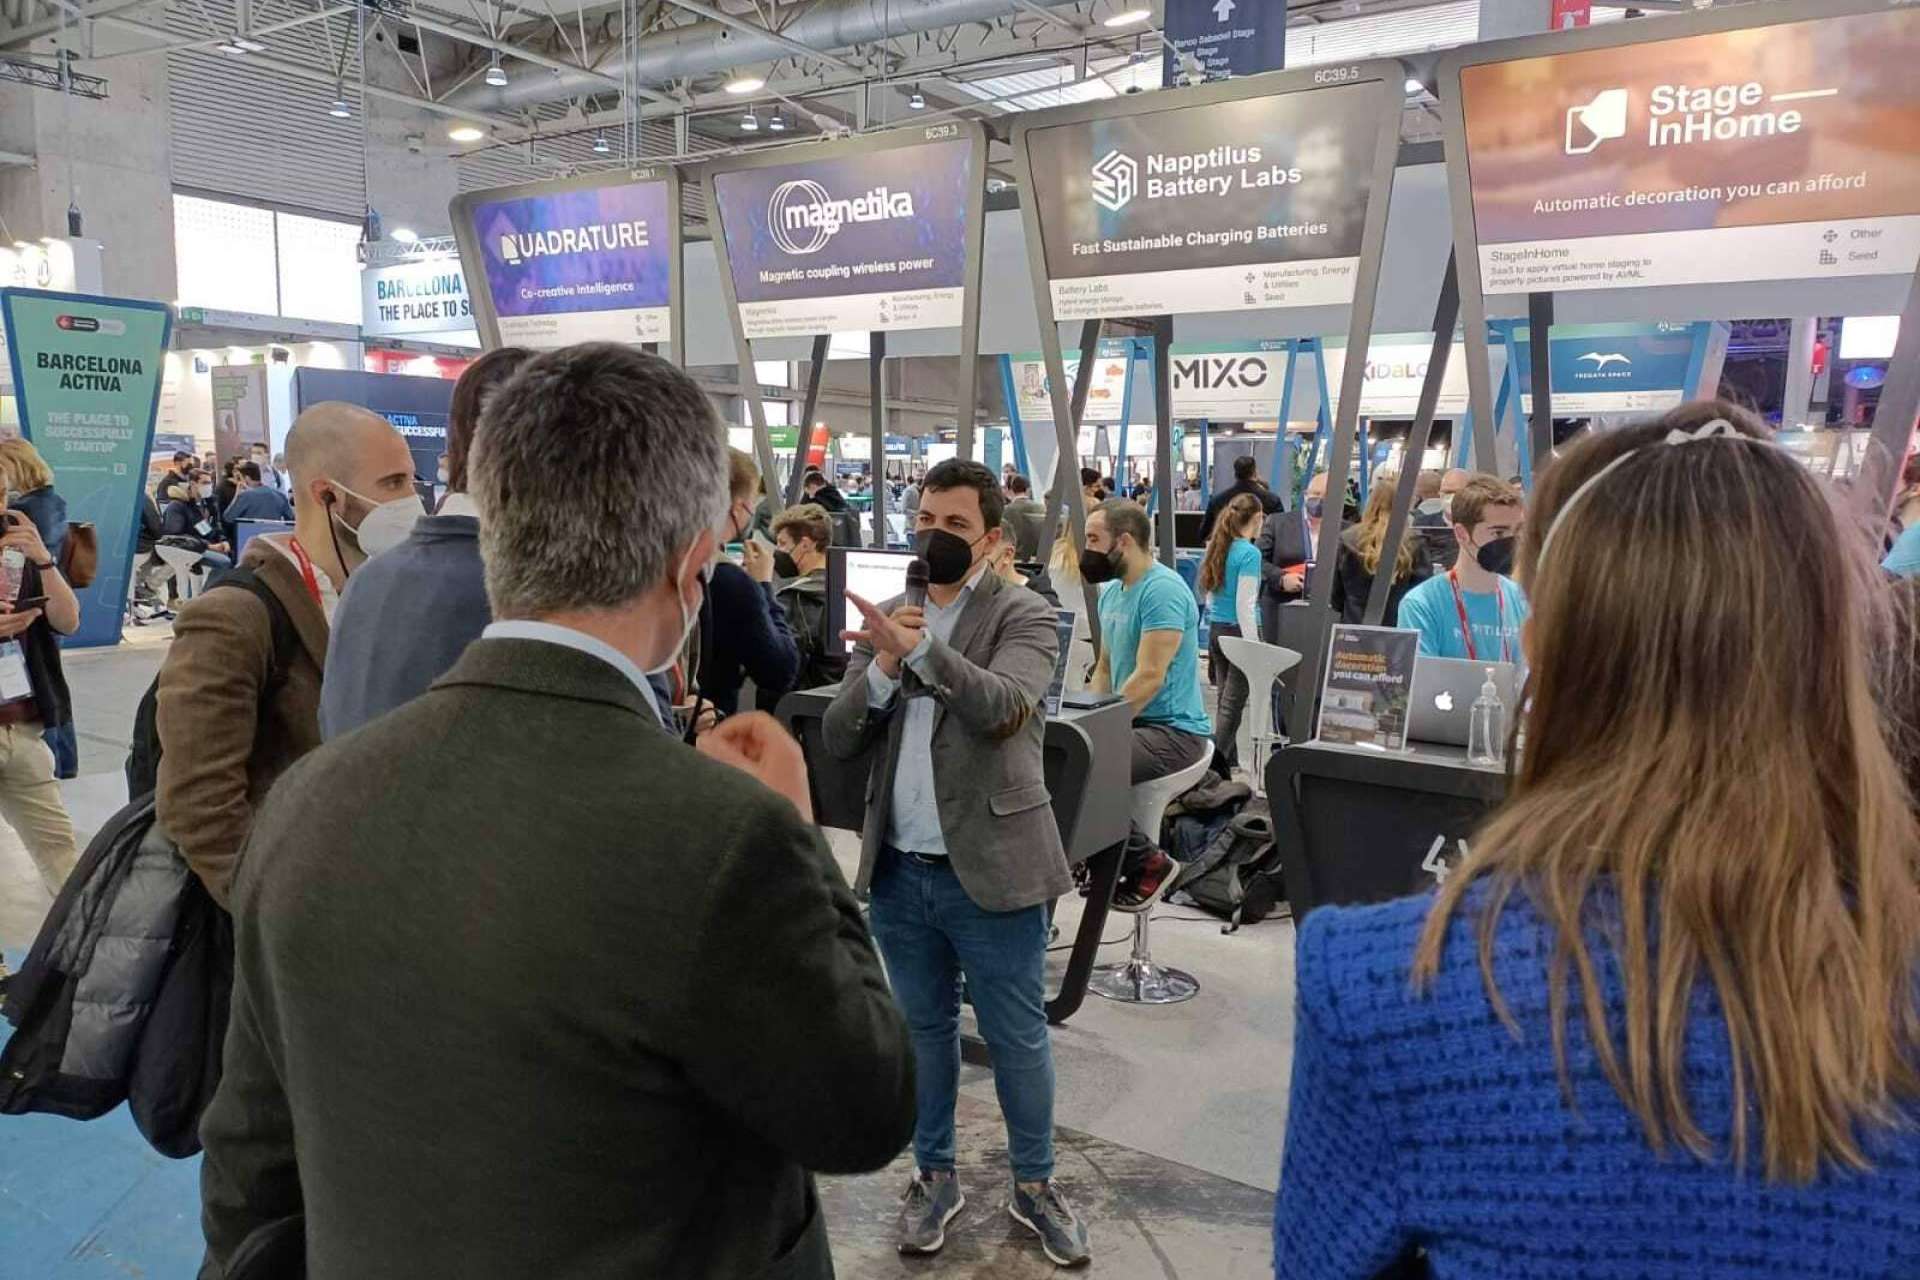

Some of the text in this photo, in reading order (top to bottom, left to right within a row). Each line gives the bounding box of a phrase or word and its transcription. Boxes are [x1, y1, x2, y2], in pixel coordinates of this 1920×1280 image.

[1314, 66, 1359, 83] 6C39.5
[1649, 80, 1764, 117] Stage
[925, 124, 958, 140] 6C39.3
[1648, 107, 1802, 147] InHome
[1147, 145, 1262, 179] Napptilus
[1147, 164, 1303, 199] Battery Labs
[1533, 172, 1867, 214] Automatic decoration you can afford
[785, 186, 914, 234] magnetika
[1072, 221, 1328, 256] Fast Sustainable Charging Batteries
[1850, 227, 1883, 241] Other
[1490, 248, 1570, 263] StageInHome
[1848, 249, 1879, 262] Seed
[760, 257, 935, 285] Magnetic coupling wireless power
[521, 284, 575, 300] Co-creative
[379, 304, 400, 322] THE
[403, 301, 439, 321] PLACE
[442, 299, 457, 318] TO
[37, 352, 143, 376] BARCELONA
[1174, 357, 1268, 389] MIXO
[60, 373, 122, 393] ACTIVA
[48, 411, 129, 427] THE PLACE TO
[45, 425, 134, 441] SUCCESSFULLY
[395, 425, 447, 438] UCCESSFU
[64, 440, 118, 454] STARTUP
[1333, 670, 1351, 680] you
[1371, 672, 1405, 684] afford
